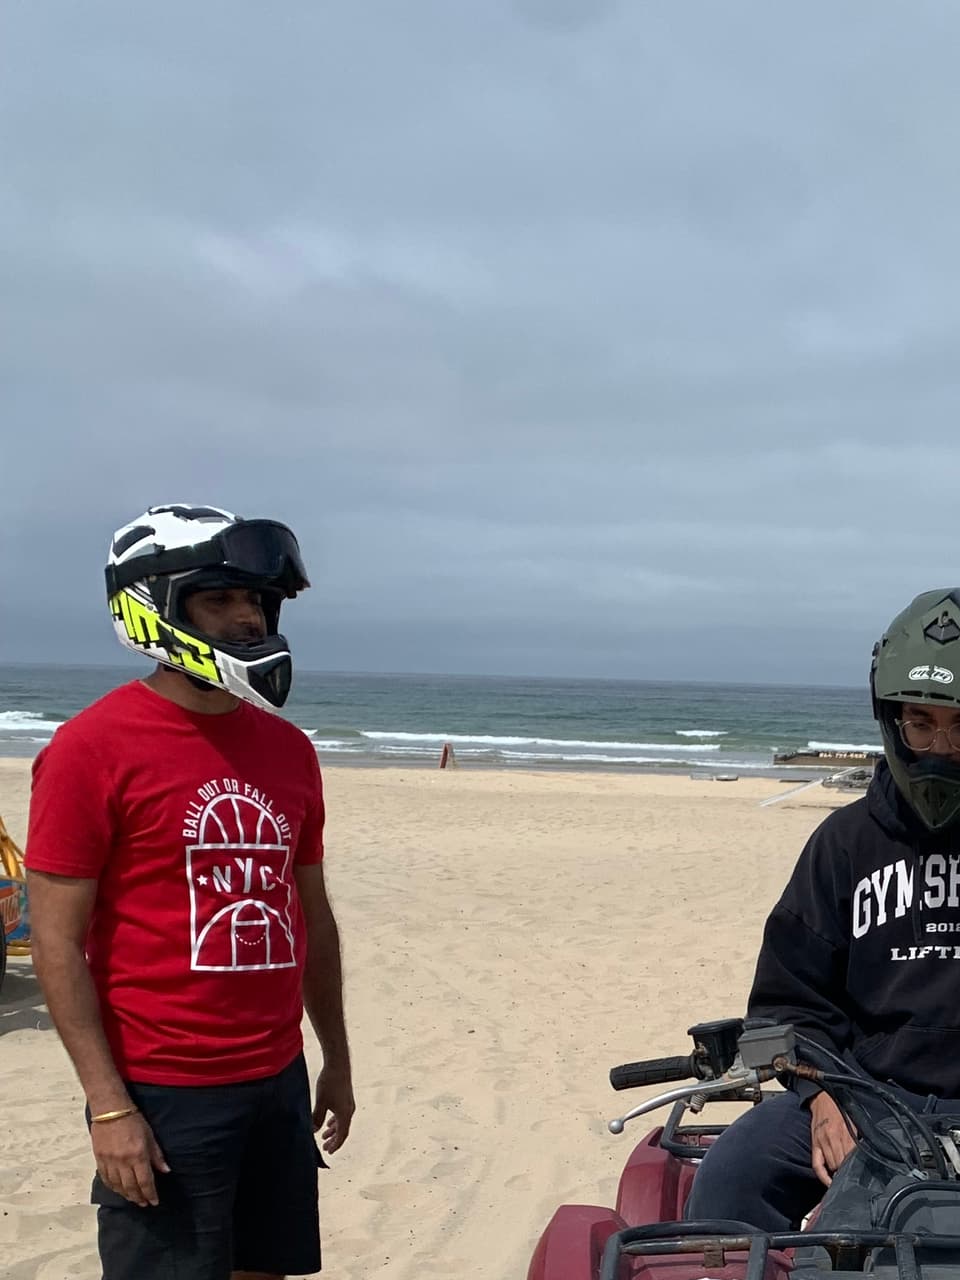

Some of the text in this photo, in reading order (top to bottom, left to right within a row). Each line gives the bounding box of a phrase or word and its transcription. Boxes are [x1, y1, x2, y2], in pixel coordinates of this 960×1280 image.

[182, 778, 291, 840] BALL OUT OR FALL OUT
[213, 857, 276, 893] NYC
